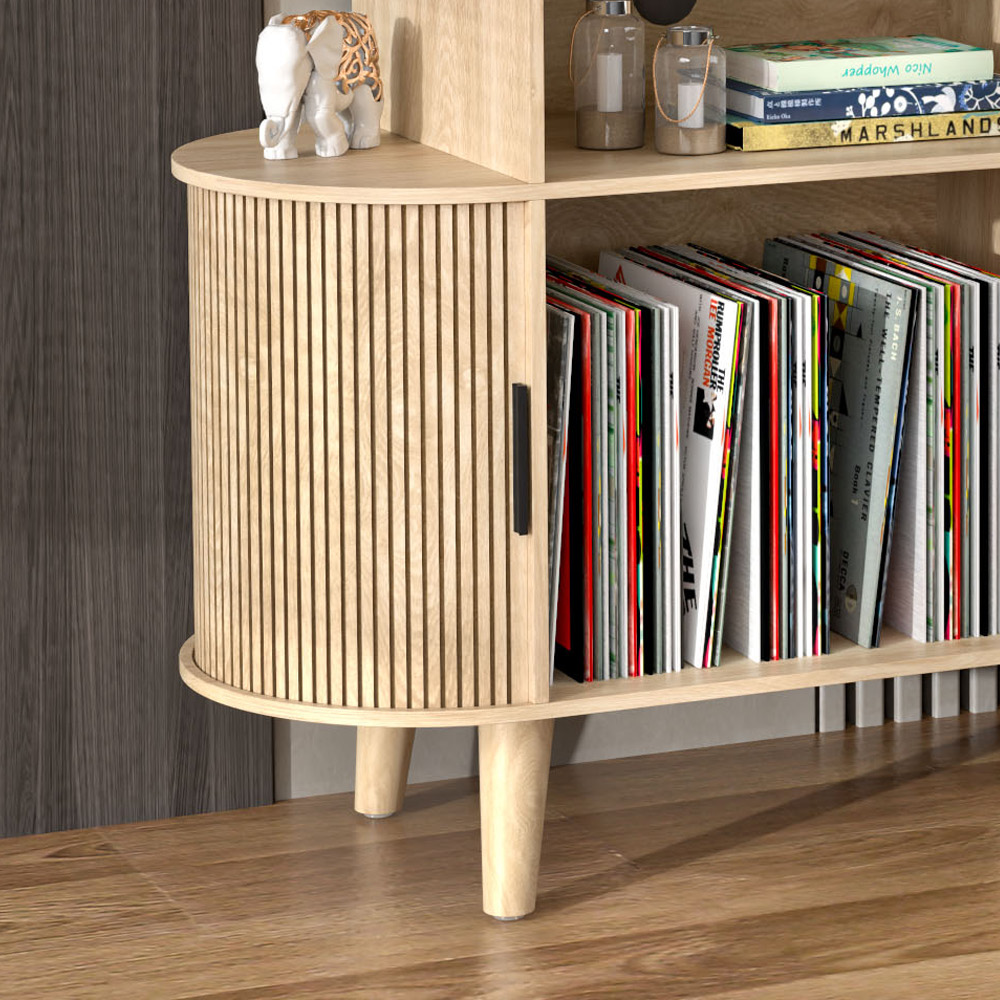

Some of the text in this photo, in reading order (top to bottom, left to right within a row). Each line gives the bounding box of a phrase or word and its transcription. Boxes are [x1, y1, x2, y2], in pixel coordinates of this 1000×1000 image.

[842, 63, 932, 78] Nico Whopper
[884, 293, 892, 319] THE
[702, 326, 715, 388] MORGAN
[890, 323, 900, 361] BACH
[717, 368, 726, 394] THE
[852, 465, 861, 495] Book
[861, 461, 874, 522] CLAVIER
[838, 550, 850, 592] DECCA
